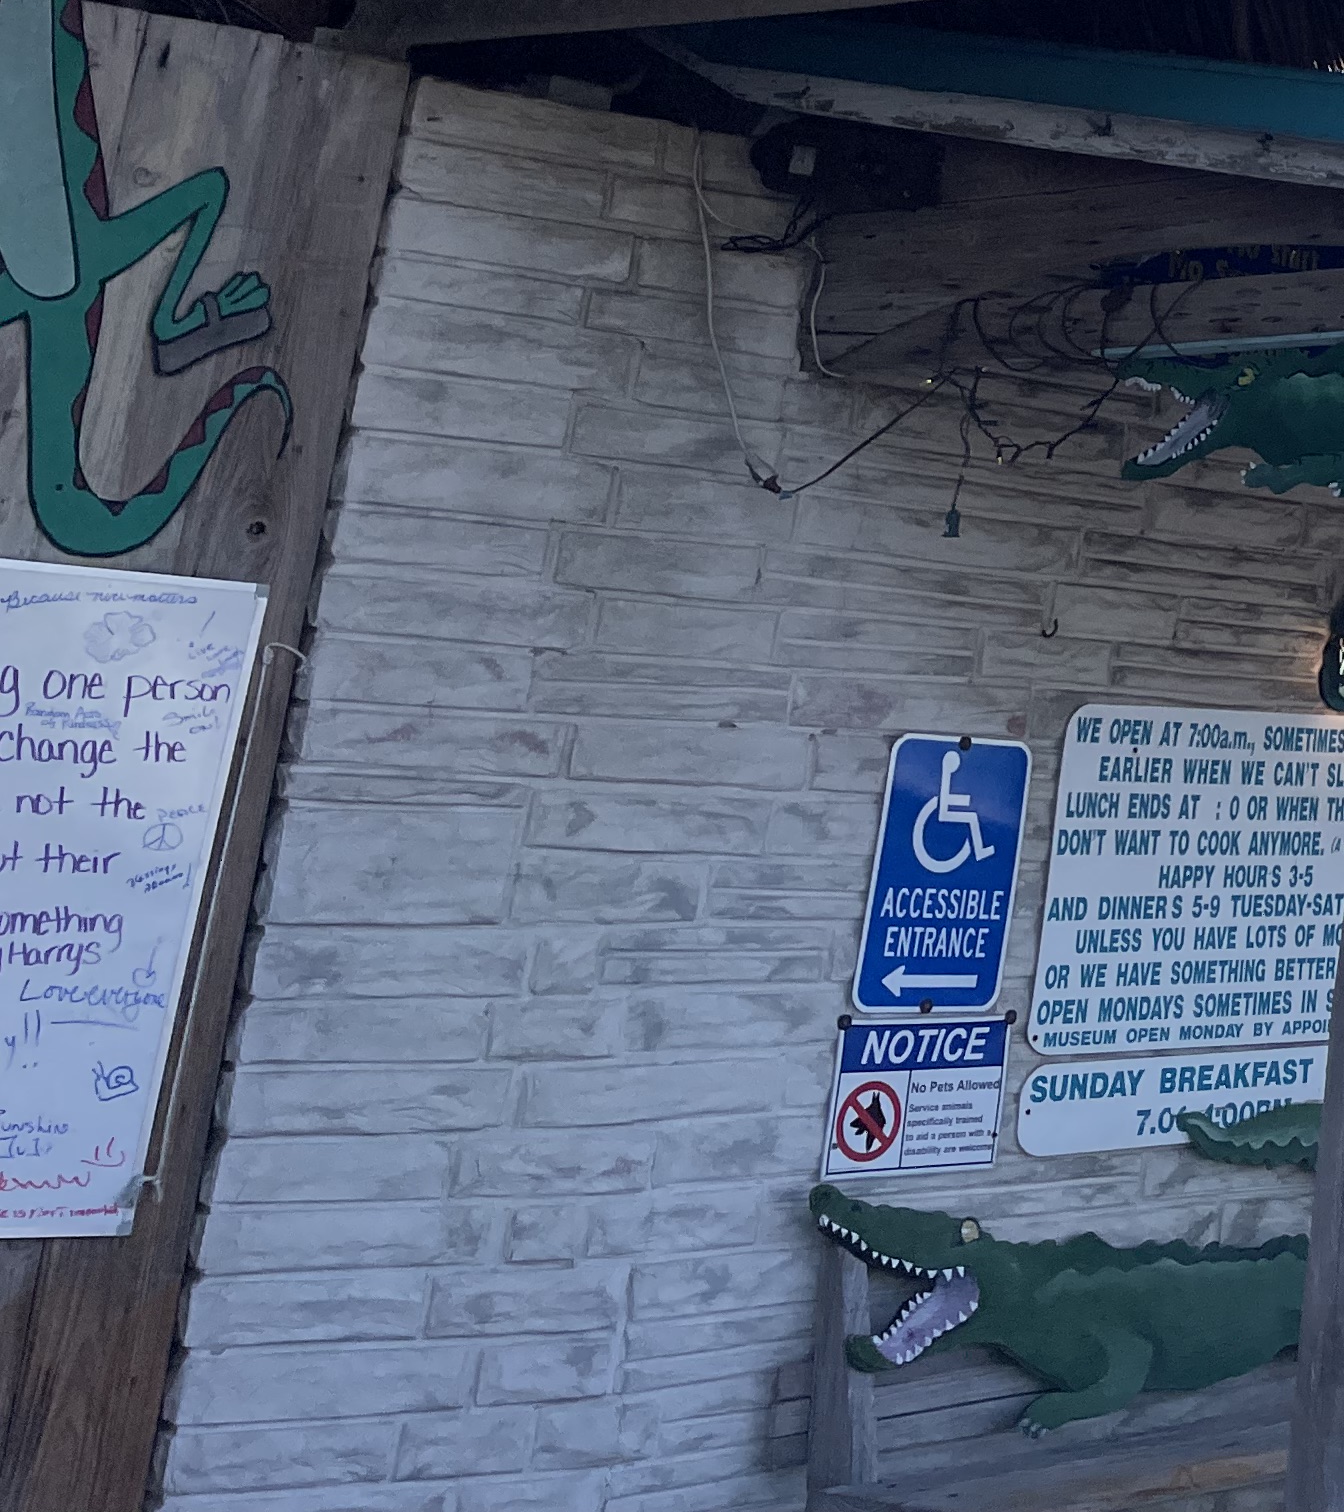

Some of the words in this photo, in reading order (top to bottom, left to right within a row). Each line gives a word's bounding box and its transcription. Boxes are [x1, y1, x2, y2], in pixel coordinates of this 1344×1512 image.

[43, 669, 105, 700] one
[123, 675, 231, 718] person
[133, 730, 186, 763] the
[1076, 716, 1102, 743] WE
[1110, 718, 1153, 744] OPEN
[1159, 721, 1183, 746] AT
[1098, 756, 1172, 783] EARLIER
[1183, 759, 1231, 785] WHEN
[1240, 761, 1265, 785] WE
[1273, 762, 1319, 787] CAN'T
[16, 786, 74, 815] not
[90, 786, 145, 820] the
[1065, 792, 1119, 818] LUNCH
[1127, 793, 1170, 819] ENDS
[1178, 794, 1201, 819] AT
[1247, 796, 1268, 821] OR
[1276, 796, 1319, 821] WHEN
[35, 841, 121, 874] their
[1056, 829, 1106, 855] DON'T
[1114, 830, 1161, 856] WANT
[1169, 830, 1189, 856] TO
[1197, 830, 1242, 856] COOK
[1248, 831, 1325, 856] ANYMORE.
[1158, 865, 1215, 888] HAPPY
[1289, 865, 1313, 887] 3-5
[880, 887, 1004, 921] ACCESSIBLE
[1047, 896, 1088, 921] AND
[1192, 895, 1221, 919] 5-9
[0, 906, 123, 953] omething
[884, 926, 989, 958] ENTRANCE
[1075, 928, 1142, 954] UNLESS
[1152, 927, 1185, 951] YOU
[1193, 926, 1238, 950] HAVE
[1246, 925, 1287, 948] LOTS
[1294, 924, 1316, 947] OF
[8, 941, 101, 976] Harrys
[1045, 964, 1070, 989] OR
[1080, 963, 1108, 988] WE
[1116, 962, 1162, 987] HAVE
[1171, 959, 1266, 985] SOMETHING
[1274, 957, 1336, 981] BETTER
[1036, 998, 1088, 1025] OPEN
[1099, 994, 1184, 1023] MONDAYS
[1193, 990, 1292, 1017] SOMETIMES
[1302, 990, 1318, 1013] IN
[861, 1026, 990, 1065] NOTICE
[1043, 1029, 1117, 1047] MUSEUM
[1126, 1027, 1170, 1043] OPEN
[1179, 1023, 1244, 1040] MONDAY
[1253, 1022, 1272, 1036] BY
[1282, 1019, 1330, 1034] APPOI
[911, 1082, 926, 1094] No
[929, 1080, 954, 1092] Pets
[957, 1079, 1000, 1091] Allowed
[1029, 1069, 1145, 1103] SUNDAY
[1159, 1058, 1314, 1094] BREAKFAST
[907, 1116, 953, 1128] specifically
[955, 1115, 983, 1124] trained
[909, 1103, 939, 1113] Service
[941, 1101, 973, 1111] animals
[903, 1145, 941, 1157] disability
[943, 1145, 956, 1153] are
[905, 1133, 913, 1142] to
[915, 1131, 928, 1141] aid
[938, 1131, 966, 1143] person
[968, 1129, 984, 1138] with
